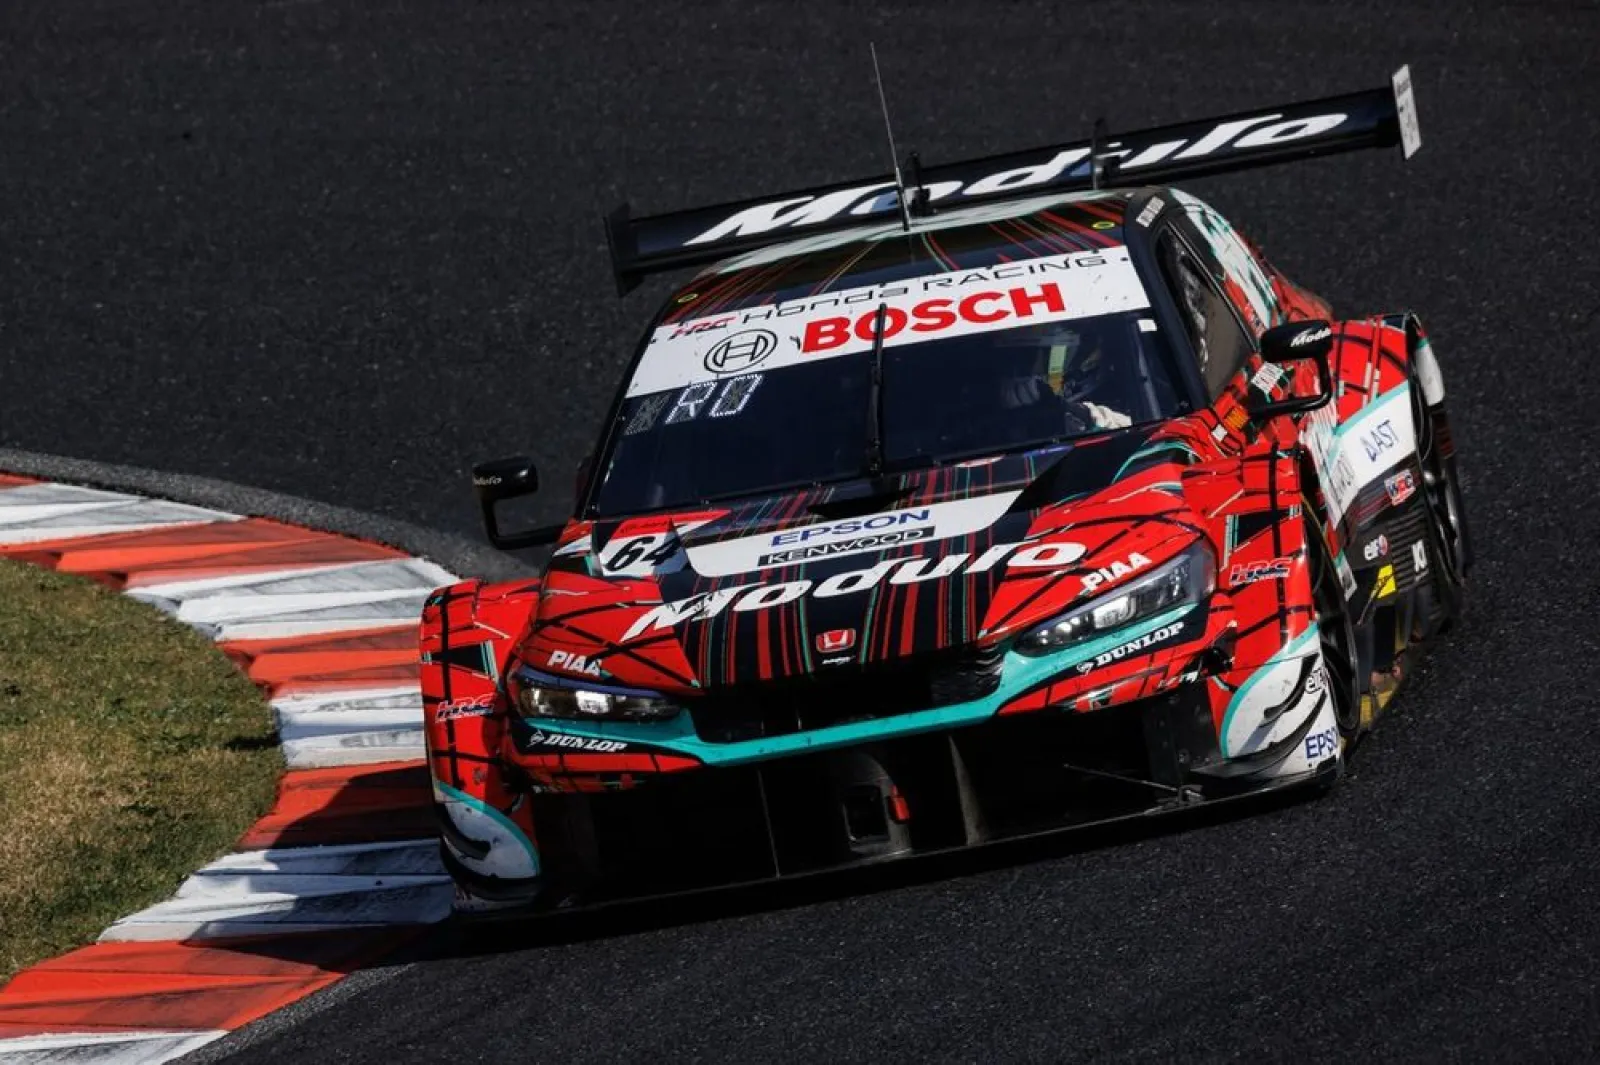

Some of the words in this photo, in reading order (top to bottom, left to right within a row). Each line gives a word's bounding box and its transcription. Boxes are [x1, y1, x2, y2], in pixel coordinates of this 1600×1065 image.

[742, 286, 909, 324] Honda
[922, 255, 1108, 292] RACING
[801, 282, 1066, 354] BOSCH
[766, 529, 924, 565] KENWOOD
[771, 509, 931, 548] EPSON
[606, 535, 681, 573] 64
[1080, 551, 1153, 593] PIAA
[620, 538, 1088, 642] Modulo
[546, 650, 603, 676] PIAA
[1095, 621, 1185, 667] DUNLOP
[542, 733, 628, 753] DUNLOP
